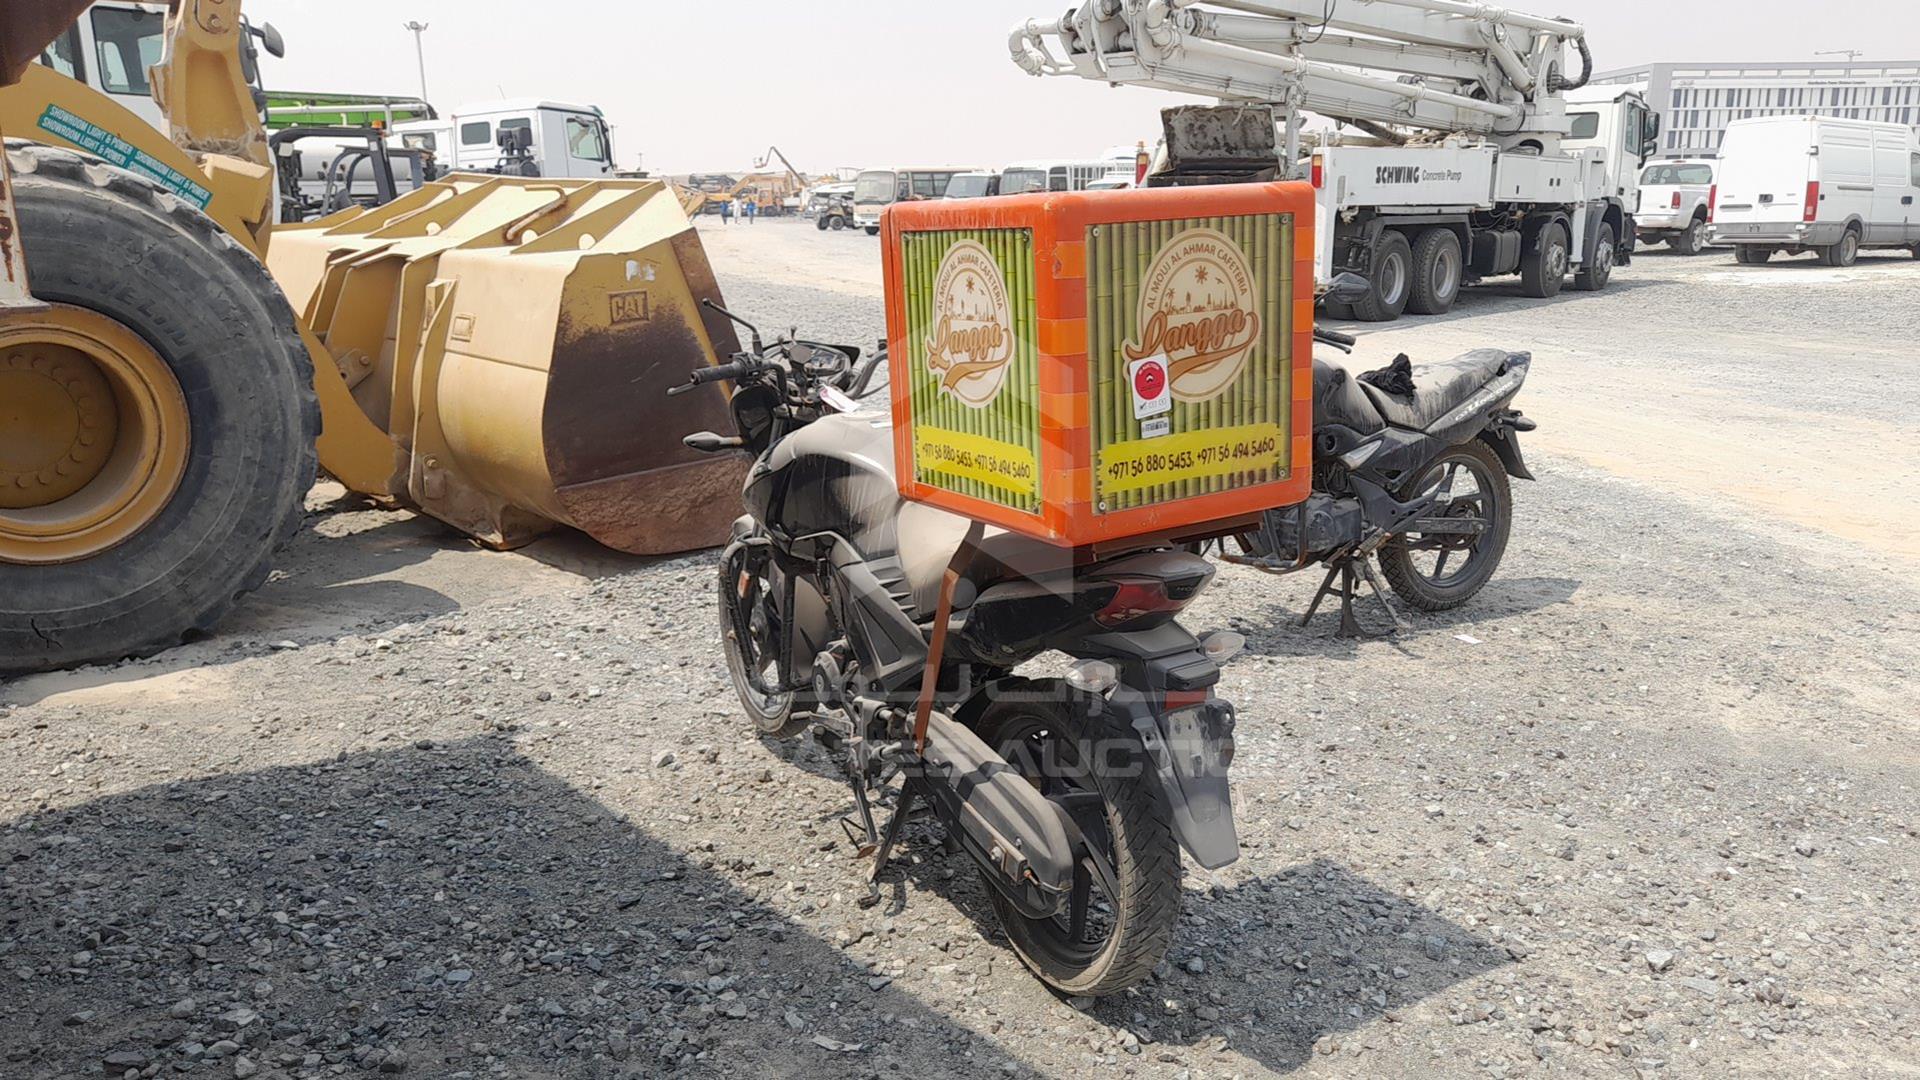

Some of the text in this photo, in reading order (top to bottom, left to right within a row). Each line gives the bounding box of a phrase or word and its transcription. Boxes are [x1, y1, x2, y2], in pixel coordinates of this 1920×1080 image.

[41, 117, 81, 142] SHOWROOM
[79, 135, 100, 151] LIGHT
[103, 147, 126, 166] POWER
[50, 106, 88, 132] SHOWROOM
[87, 125, 107, 141] LIGHT
[111, 137, 134, 155] POWER
[135, 150, 170, 175] SHOWROOM
[167, 168, 187, 186] LIGHT
[189, 182, 210, 200] POWER
[1376, 166, 1462, 184] SCHWING Concrete Pump
[957, 254, 979, 266] AHMAR
[980, 261, 1003, 310] CAFETERIA
[1147, 296, 1157, 309] AL
[1170, 252, 1181, 265] AL
[1183, 243, 1216, 256] AHMAR
[1217, 249, 1248, 296] CAFETERIA
[611, 294, 645, 321] CAT
[922, 443, 934, 457] +971
[935, 444, 942, 460] 56
[943, 444, 955, 461] 880
[975, 454, 988, 470] +971
[989, 455, 997, 472] 56
[999, 459, 1011, 475] 494
[1012, 461, 1031, 479] 5460
[1108, 461, 1129, 480] +971
[1131, 459, 1143, 477] 56
[1146, 455, 1166, 472] 880
[1197, 447, 1217, 464] +971
[1219, 443, 1230, 462] 56
[1232, 443, 1249, 459] 494
[1252, 436, 1275, 454] 5460
